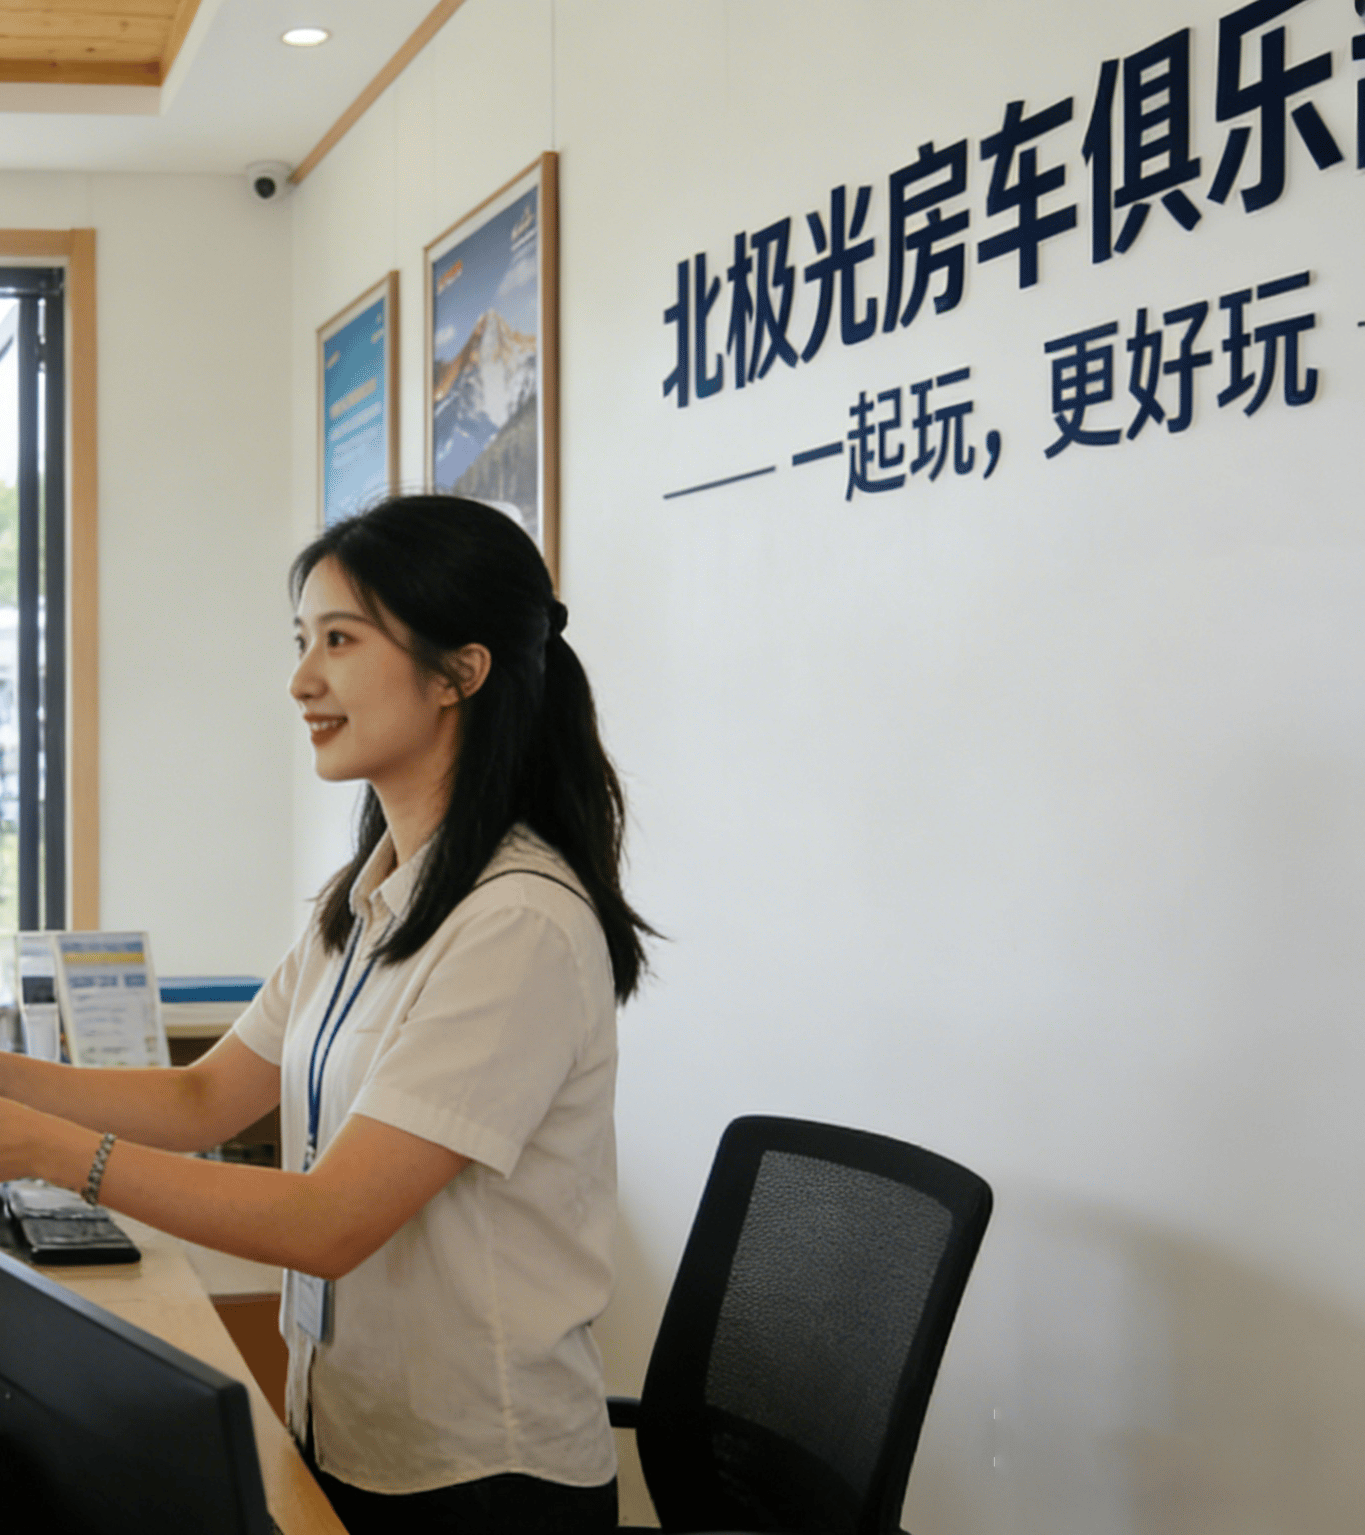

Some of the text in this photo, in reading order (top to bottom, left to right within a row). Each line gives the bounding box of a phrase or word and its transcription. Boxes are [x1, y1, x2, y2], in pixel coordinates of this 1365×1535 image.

[661, 0, 1365, 408] 北极光房车俱乐
